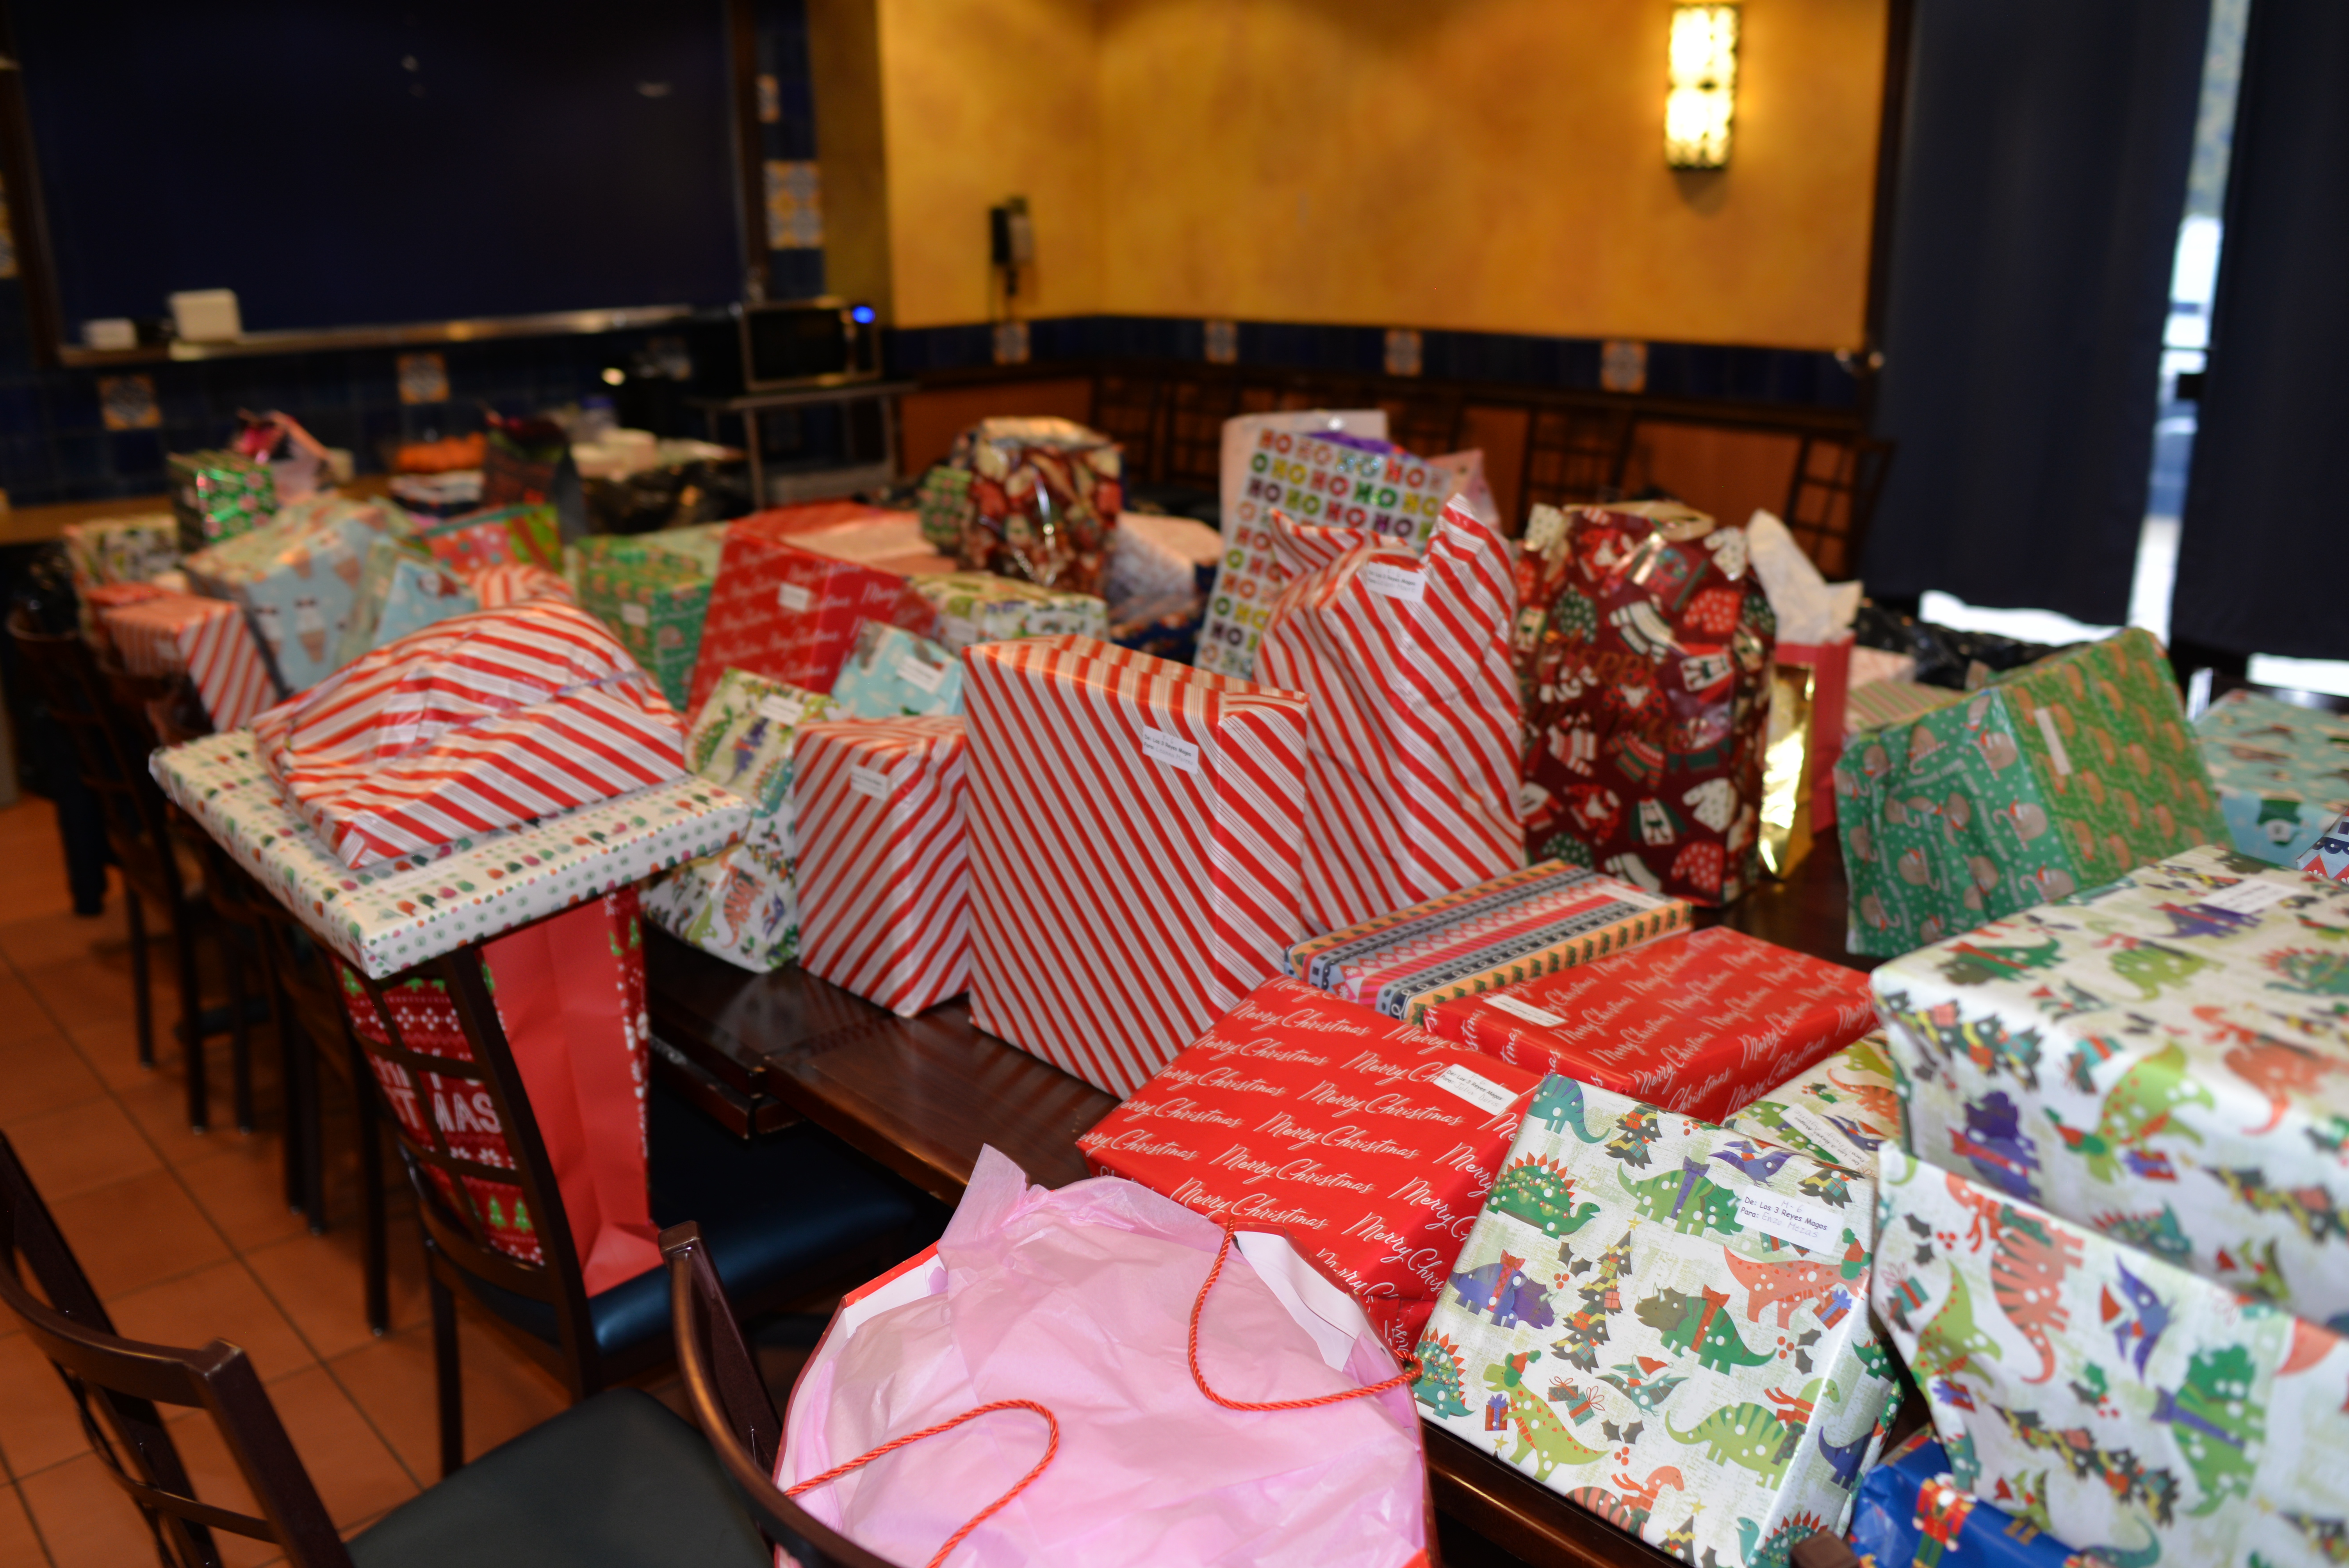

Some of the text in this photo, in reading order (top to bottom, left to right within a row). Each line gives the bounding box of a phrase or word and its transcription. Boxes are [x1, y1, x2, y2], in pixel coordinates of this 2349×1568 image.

[1165, 742, 1177, 751] Reyes
[1178, 748, 1191, 757] Magos
[1281, 1009, 1371, 1037] Christmas
[1382, 1024, 1449, 1054] Merry
[1548, 1020, 1608, 1045] Merry
[1581, 996, 1636, 1025] Christmas
[1587, 1039, 1647, 1066] Merry
[1619, 1014, 1674, 1044] Christmas
[1239, 1038, 1329, 1065] Christmas
[1340, 1050, 1408, 1085] Merry
[1628, 1062, 1676, 1095] Merry
[1660, 1031, 1716, 1068] Christmas
[1737, 1031, 1781, 1069] Merry
[1197, 1067, 1285, 1096] Christmas
[1297, 1080, 1364, 1118] Merry
[1365, 1093, 1465, 1126] Christmas
[1440, 1075, 1454, 1083] Para:
[1471, 1082, 1486, 1092] Reyes
[1486, 1090, 1502, 1101] Magos
[1794, 1116, 1813, 1131] Magos
[1813, 1131, 1830, 1144] Reyes
[1154, 1098, 1244, 1128] Christmas
[1253, 1111, 1322, 1150] Merry
[1321, 1125, 1420, 1159] Christmas
[1432, 1142, 1493, 1197] Merry
[1110, 1129, 1198, 1161] Christmas
[1208, 1143, 1278, 1185] Merry
[1276, 1158, 1375, 1194] Christmas
[1387, 1176, 1456, 1230] Merry
[1170, 1177, 1232, 1221] Merry
[1230, 1193, 1330, 1229] Christmas
[1341, 1212, 1412, 1263] Merry
[1740, 1206, 1759, 1218] Para:
[1745, 1196, 1757, 1206] De:
[1759, 1202, 1772, 1211] Los
[1781, 1209, 1802, 1222] Reyes
[1804, 1217, 1827, 1230] Magos
